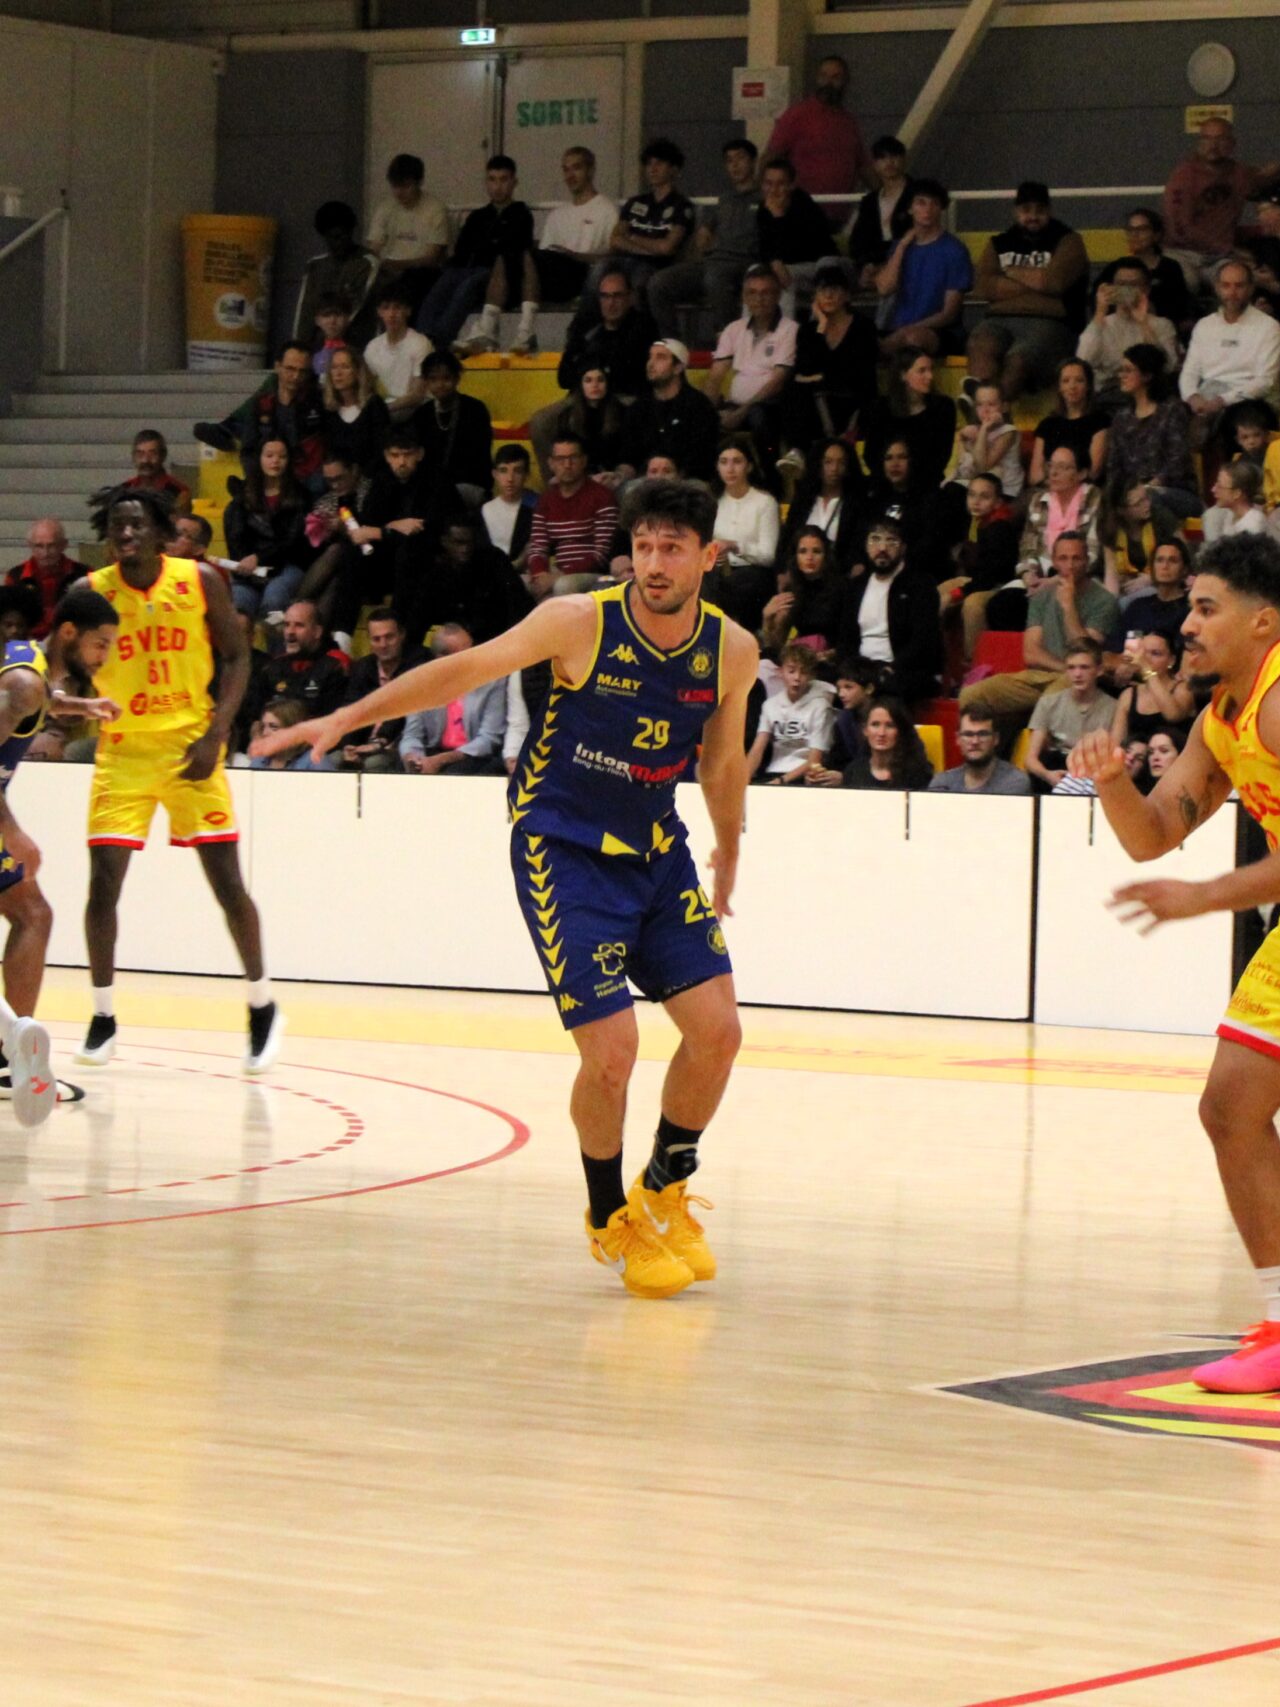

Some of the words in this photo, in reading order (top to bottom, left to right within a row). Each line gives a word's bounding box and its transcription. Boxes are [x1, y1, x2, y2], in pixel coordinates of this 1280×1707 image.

[517, 99, 598, 127] SORTIE
[597, 673, 642, 690] MARY
[632, 716, 671, 750] 29
